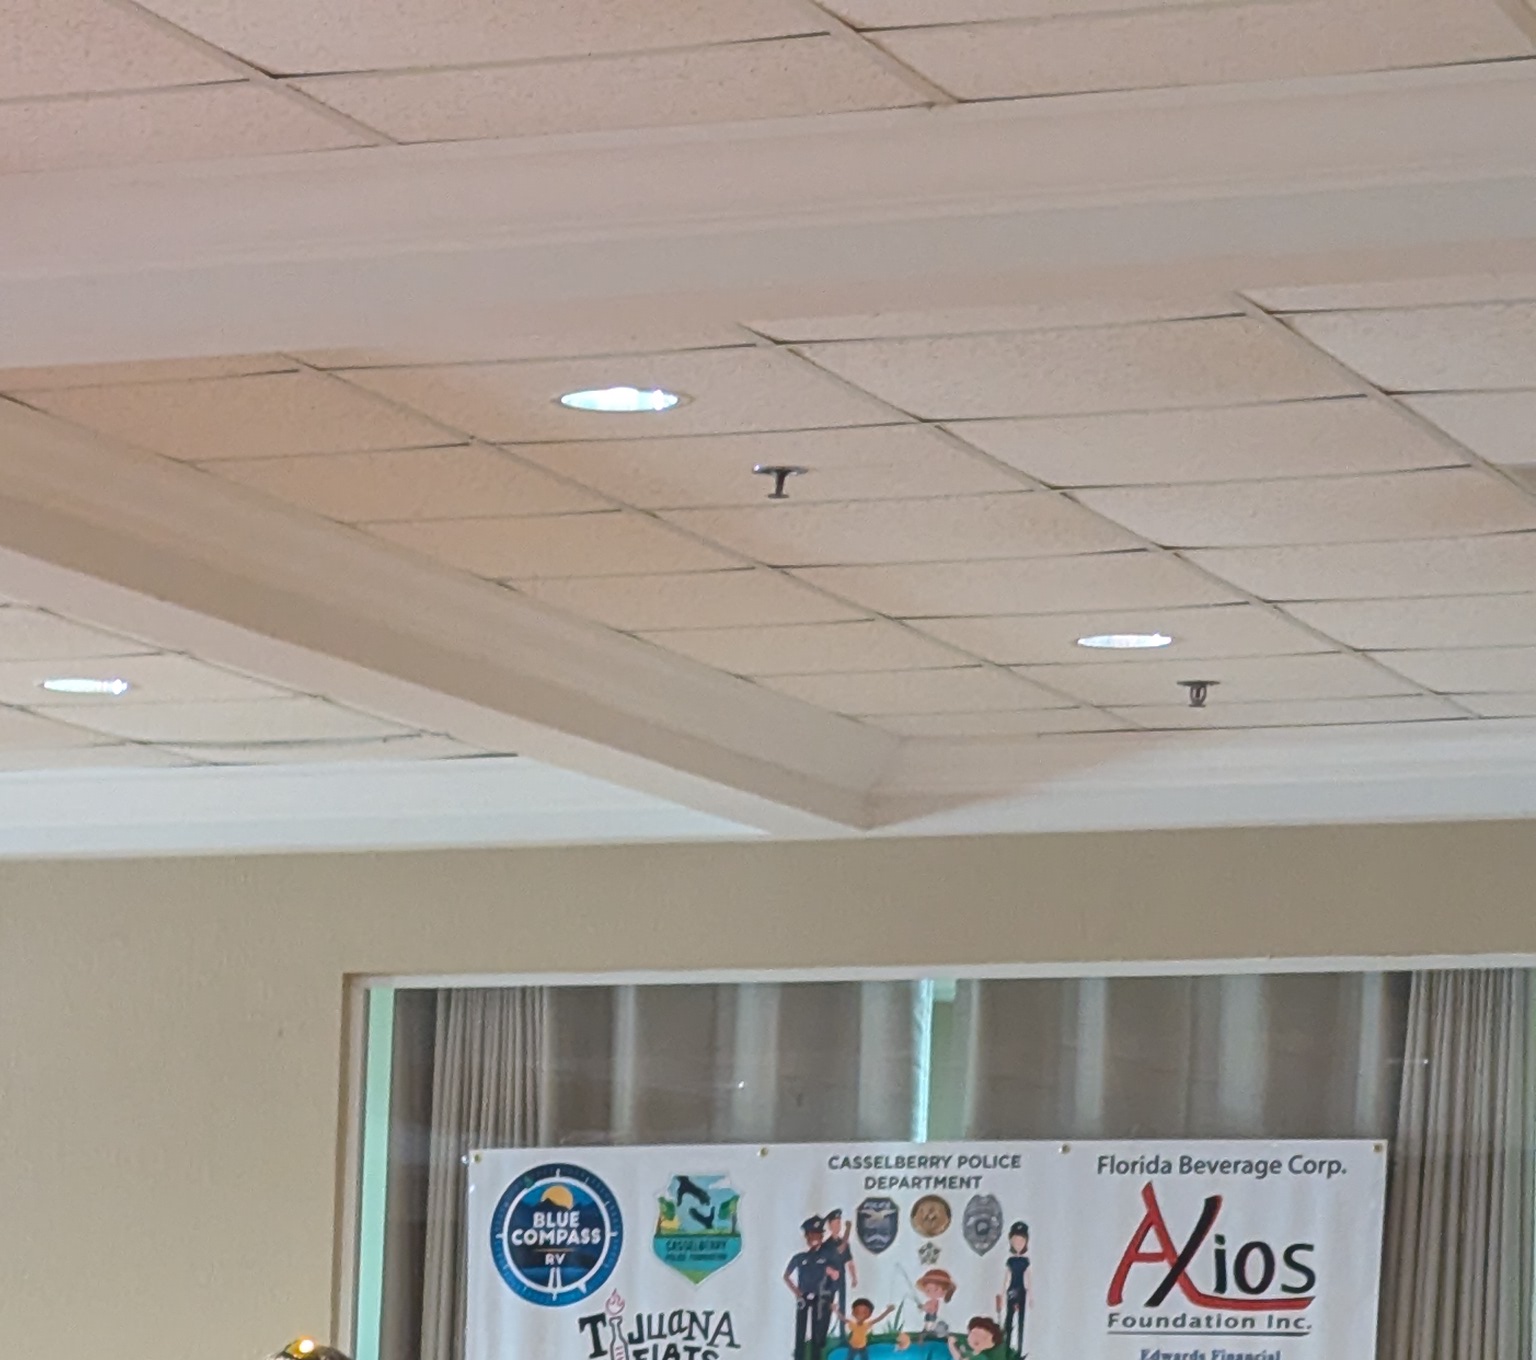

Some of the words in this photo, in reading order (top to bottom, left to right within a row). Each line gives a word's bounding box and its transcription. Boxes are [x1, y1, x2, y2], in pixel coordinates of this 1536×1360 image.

[827, 1155, 952, 1170] CASSELBERRY
[957, 1154, 1022, 1169] POLICE
[1097, 1155, 1172, 1175] Florida
[1178, 1155, 1282, 1180] Beverage
[1288, 1154, 1348, 1179] Corp.
[864, 1175, 983, 1190] DEPARTMENT
[533, 1211, 581, 1228] BLUE
[511, 1228, 602, 1246] COMPASS
[545, 1253, 566, 1266] RV
[1107, 1312, 1256, 1330] Foundation
[1266, 1314, 1313, 1330] Inc.
